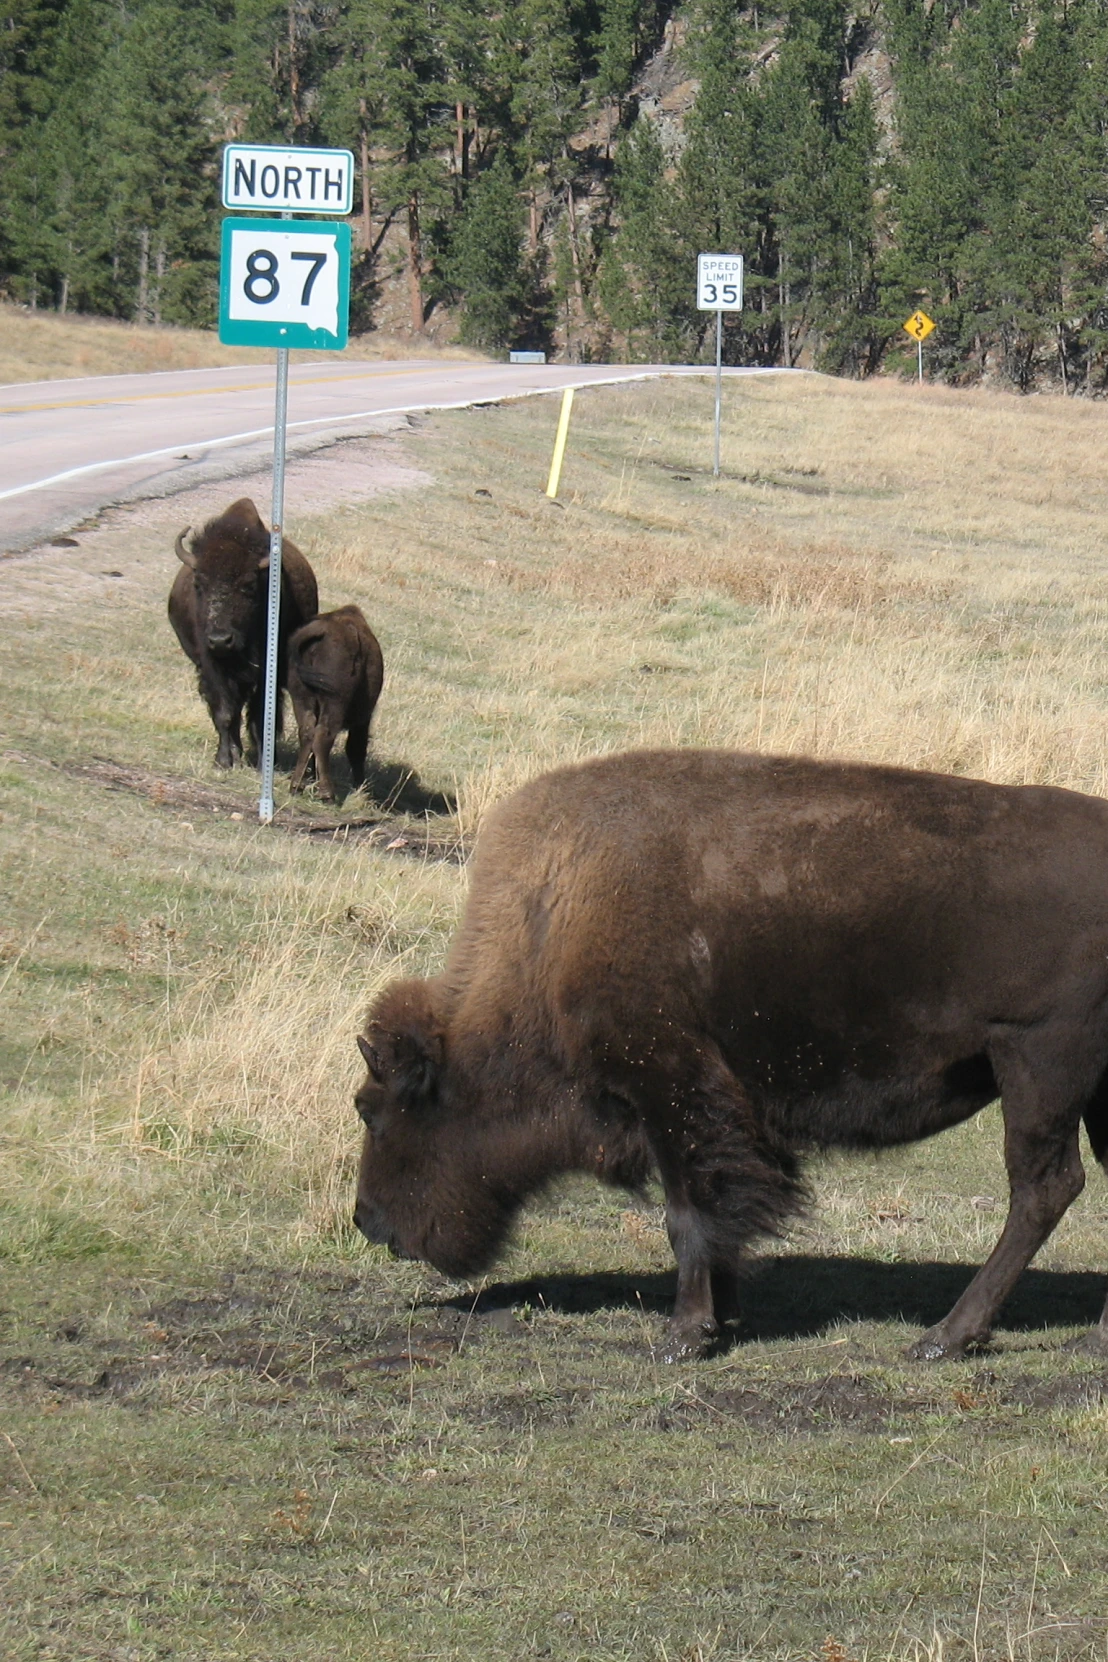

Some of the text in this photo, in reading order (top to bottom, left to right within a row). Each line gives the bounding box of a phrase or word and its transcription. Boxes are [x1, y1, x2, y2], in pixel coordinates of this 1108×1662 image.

[234, 158, 343, 201] NORTH
[702, 261, 739, 271] SPEED
[243, 249, 327, 306] 87
[706, 273, 734, 282] LIMIT
[703, 284, 737, 304] 35
